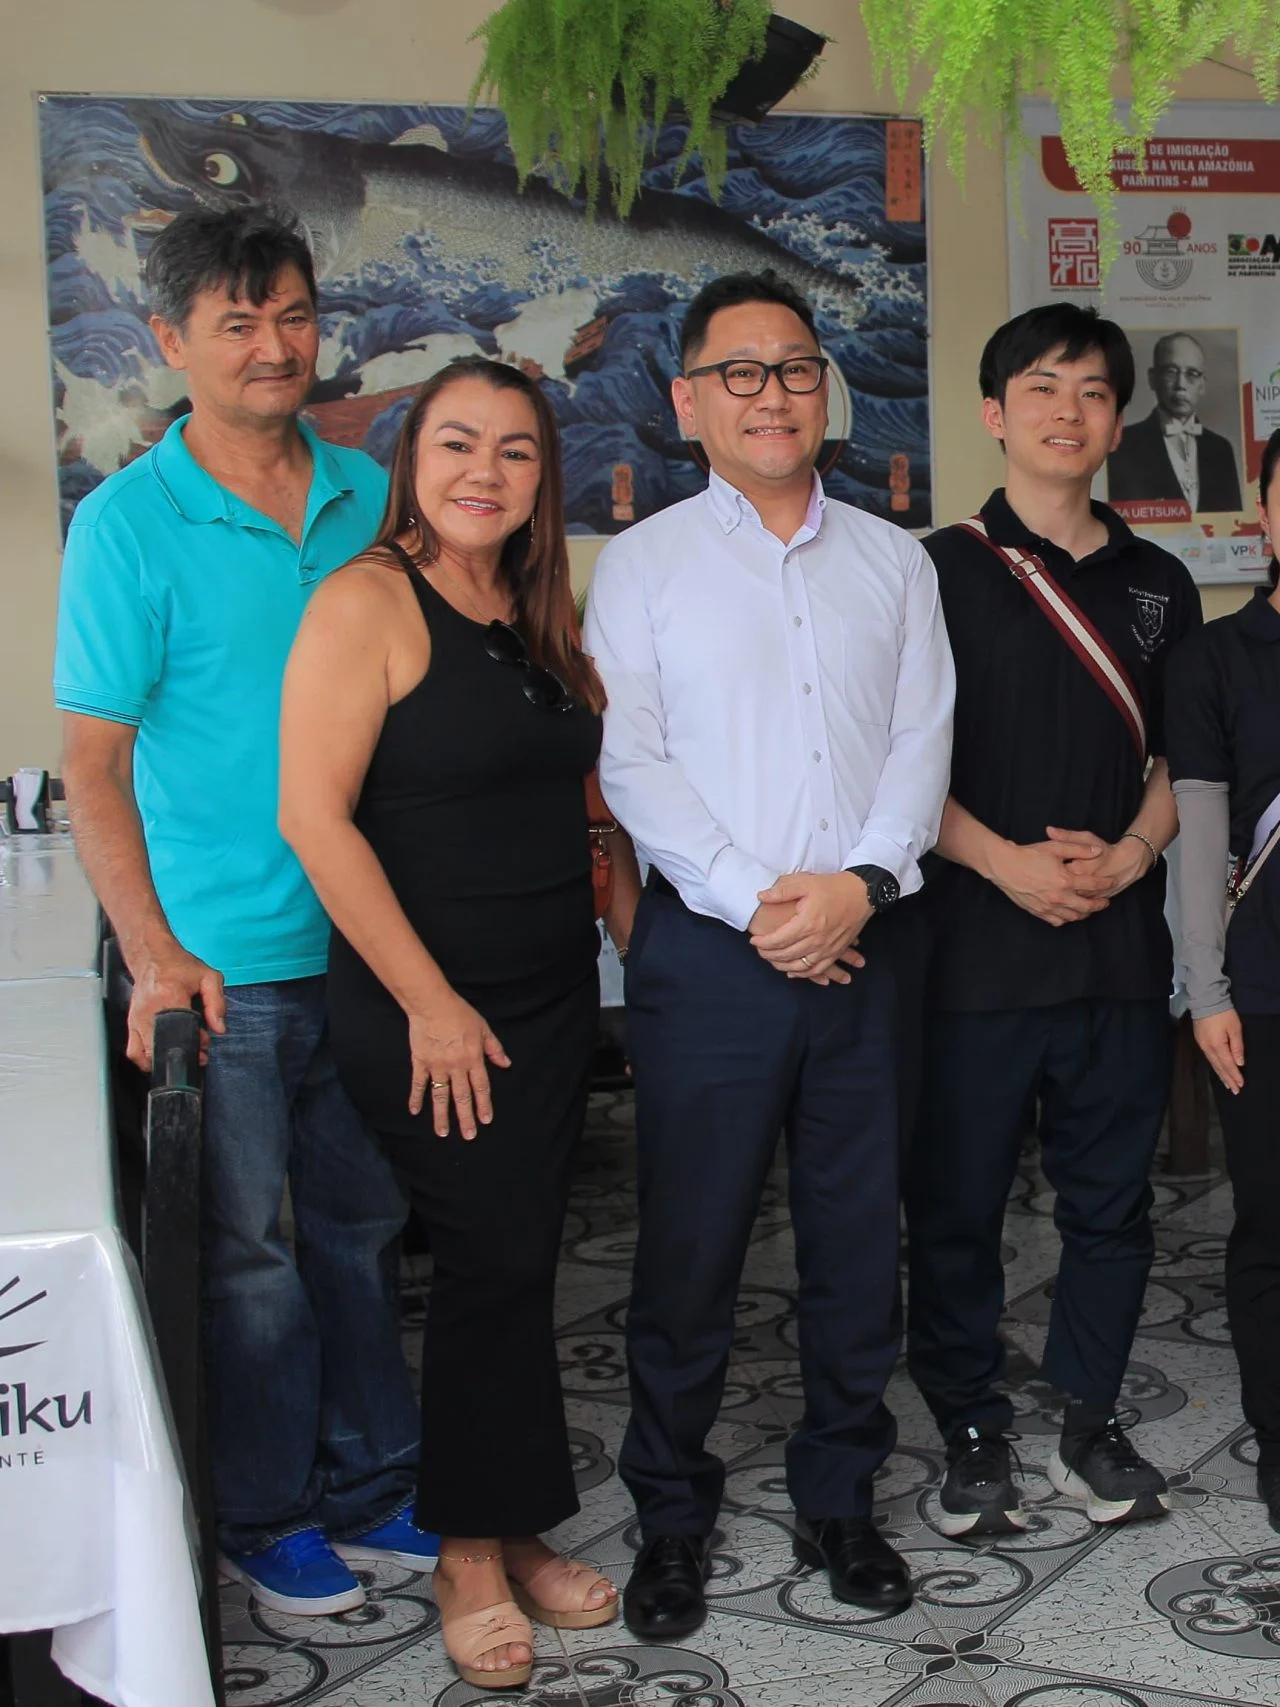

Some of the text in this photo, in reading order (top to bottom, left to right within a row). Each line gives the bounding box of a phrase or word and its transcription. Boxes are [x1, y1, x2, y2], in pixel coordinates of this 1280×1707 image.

[1150, 144, 1164, 155] DE
[1167, 144, 1229, 158] IMIGRAÇÃO
[1152, 161, 1167, 171] NA
[1170, 161, 1194, 172] VILA
[1197, 158, 1255, 172] AMAZÔNIA
[1122, 175, 1180, 187] PARINTINS
[1191, 176, 1209, 188] AM
[1123, 241, 1141, 255] 90
[1187, 242, 1217, 253] ANOS
[1131, 505, 1186, 518] UETSUKA
[1231, 545, 1256, 556] VPK
